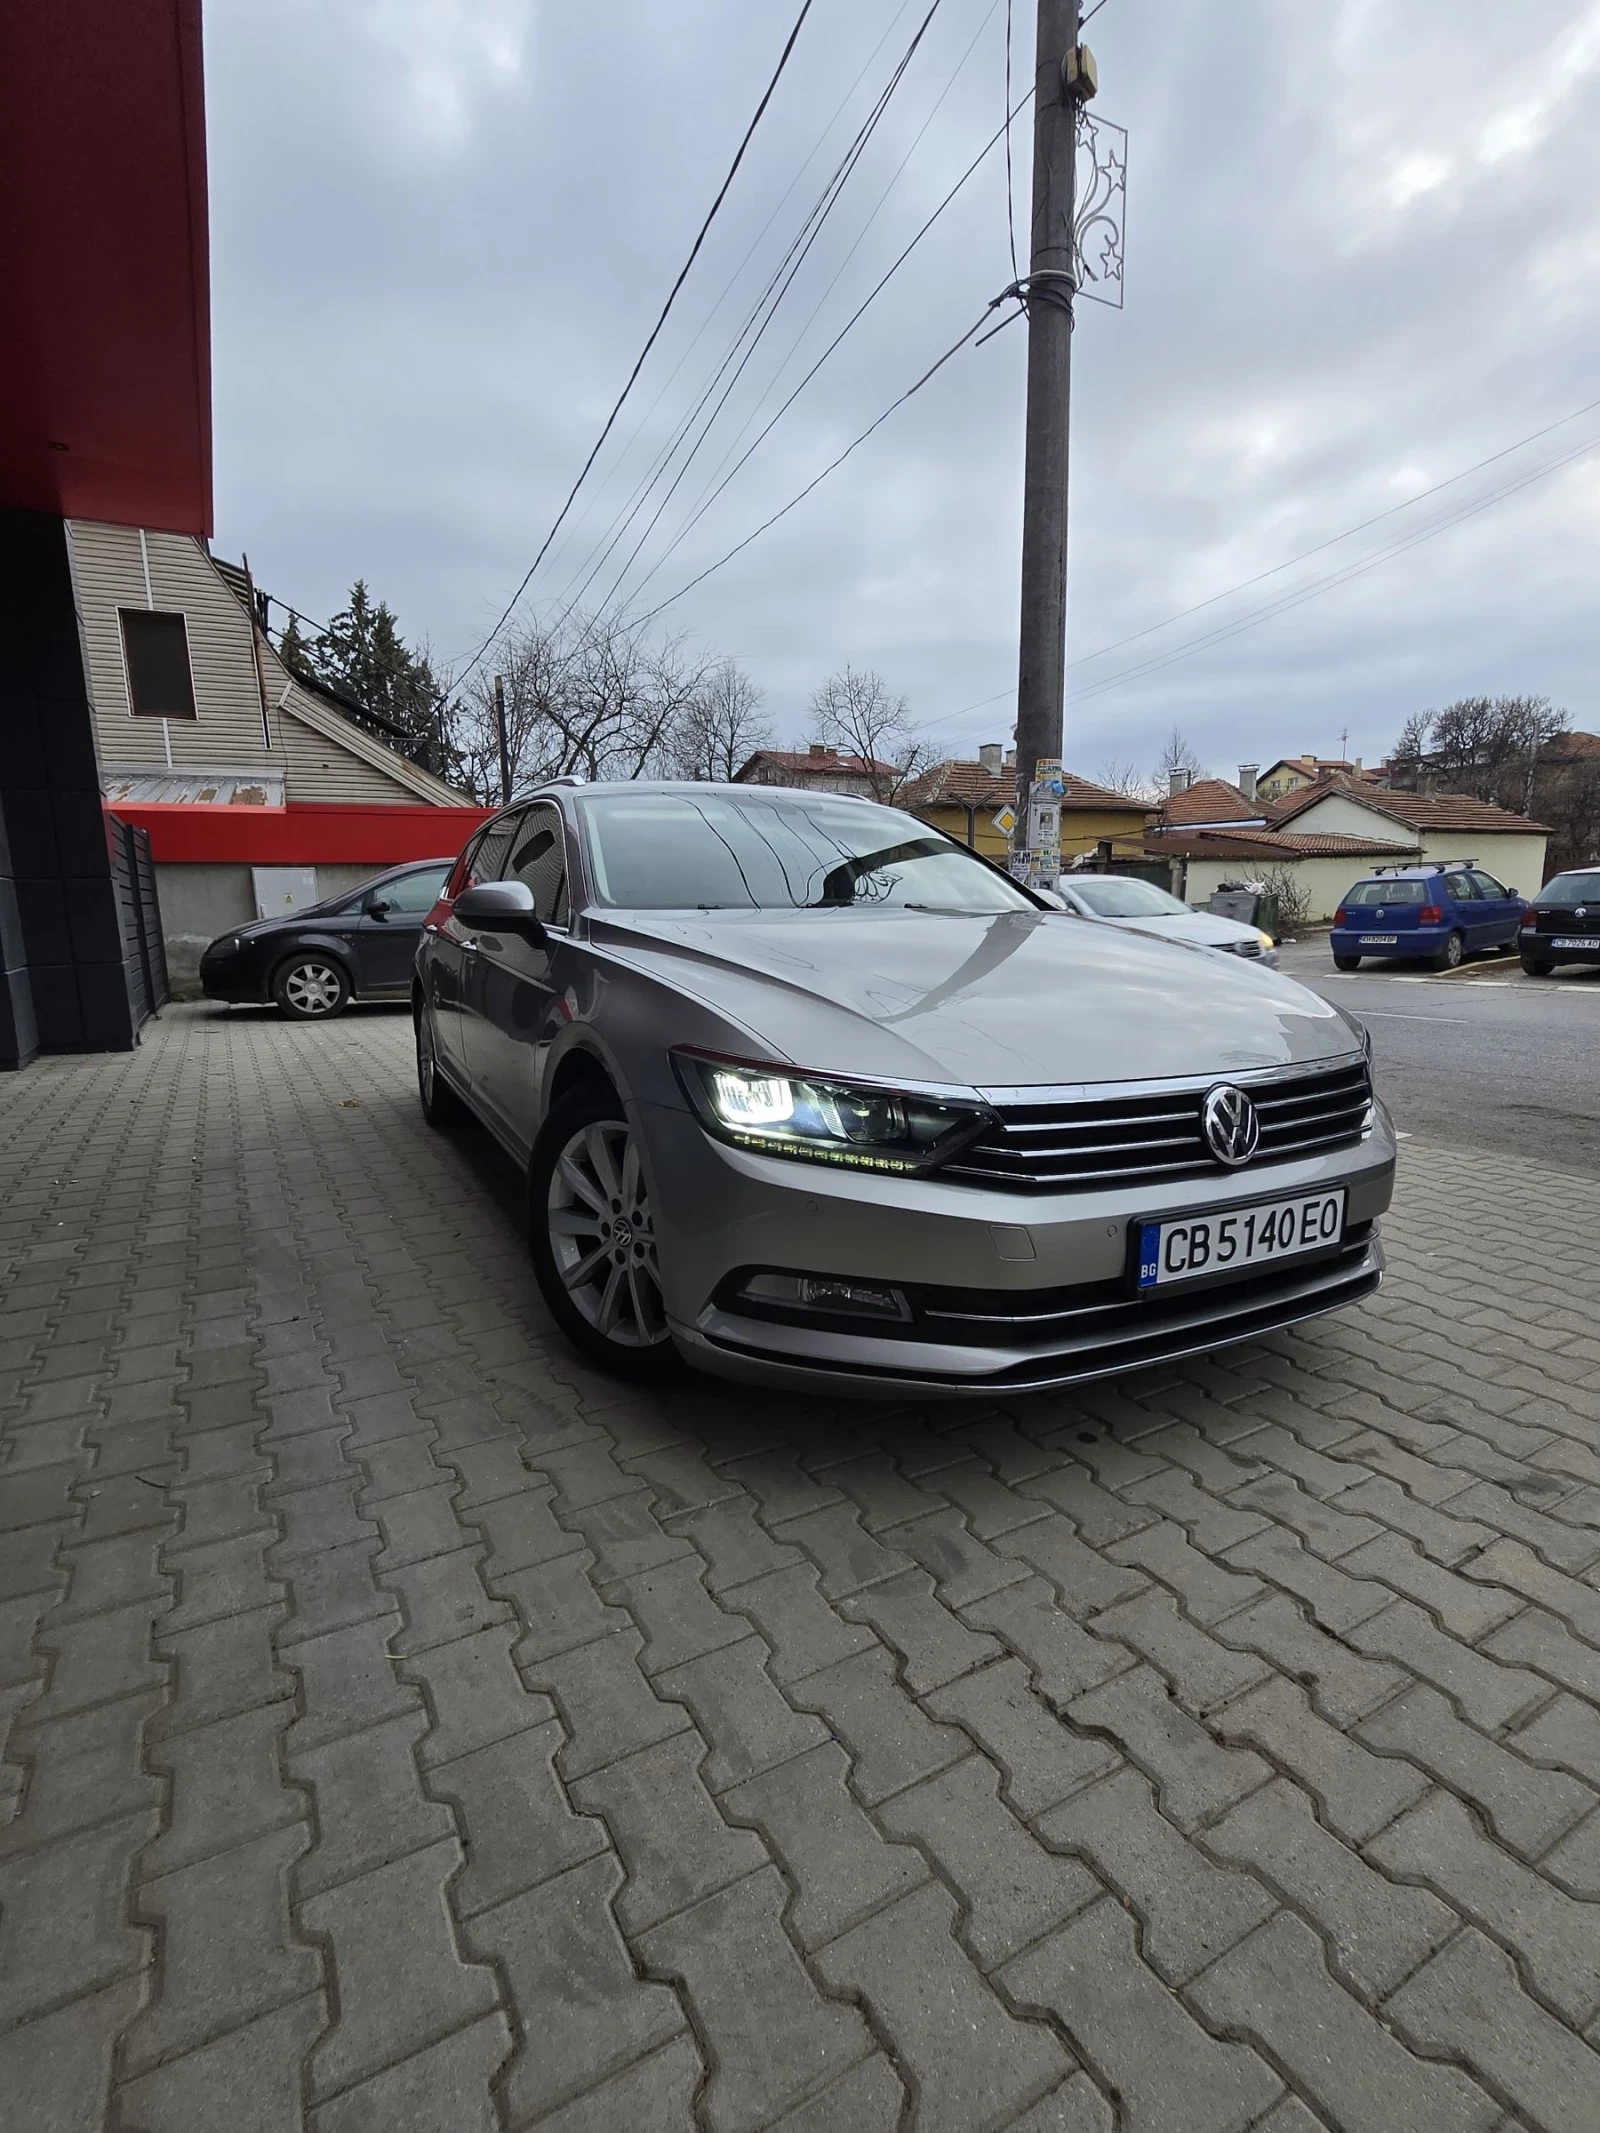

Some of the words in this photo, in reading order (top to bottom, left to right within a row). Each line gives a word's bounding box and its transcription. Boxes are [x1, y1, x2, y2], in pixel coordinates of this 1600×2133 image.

[1567, 940, 1586, 948] 7026
[1165, 1224, 1210, 1273] CB
[1217, 1207, 1295, 1262] 5140
[1300, 1198, 1338, 1244] EO
[1141, 1263, 1156, 1278] BG
